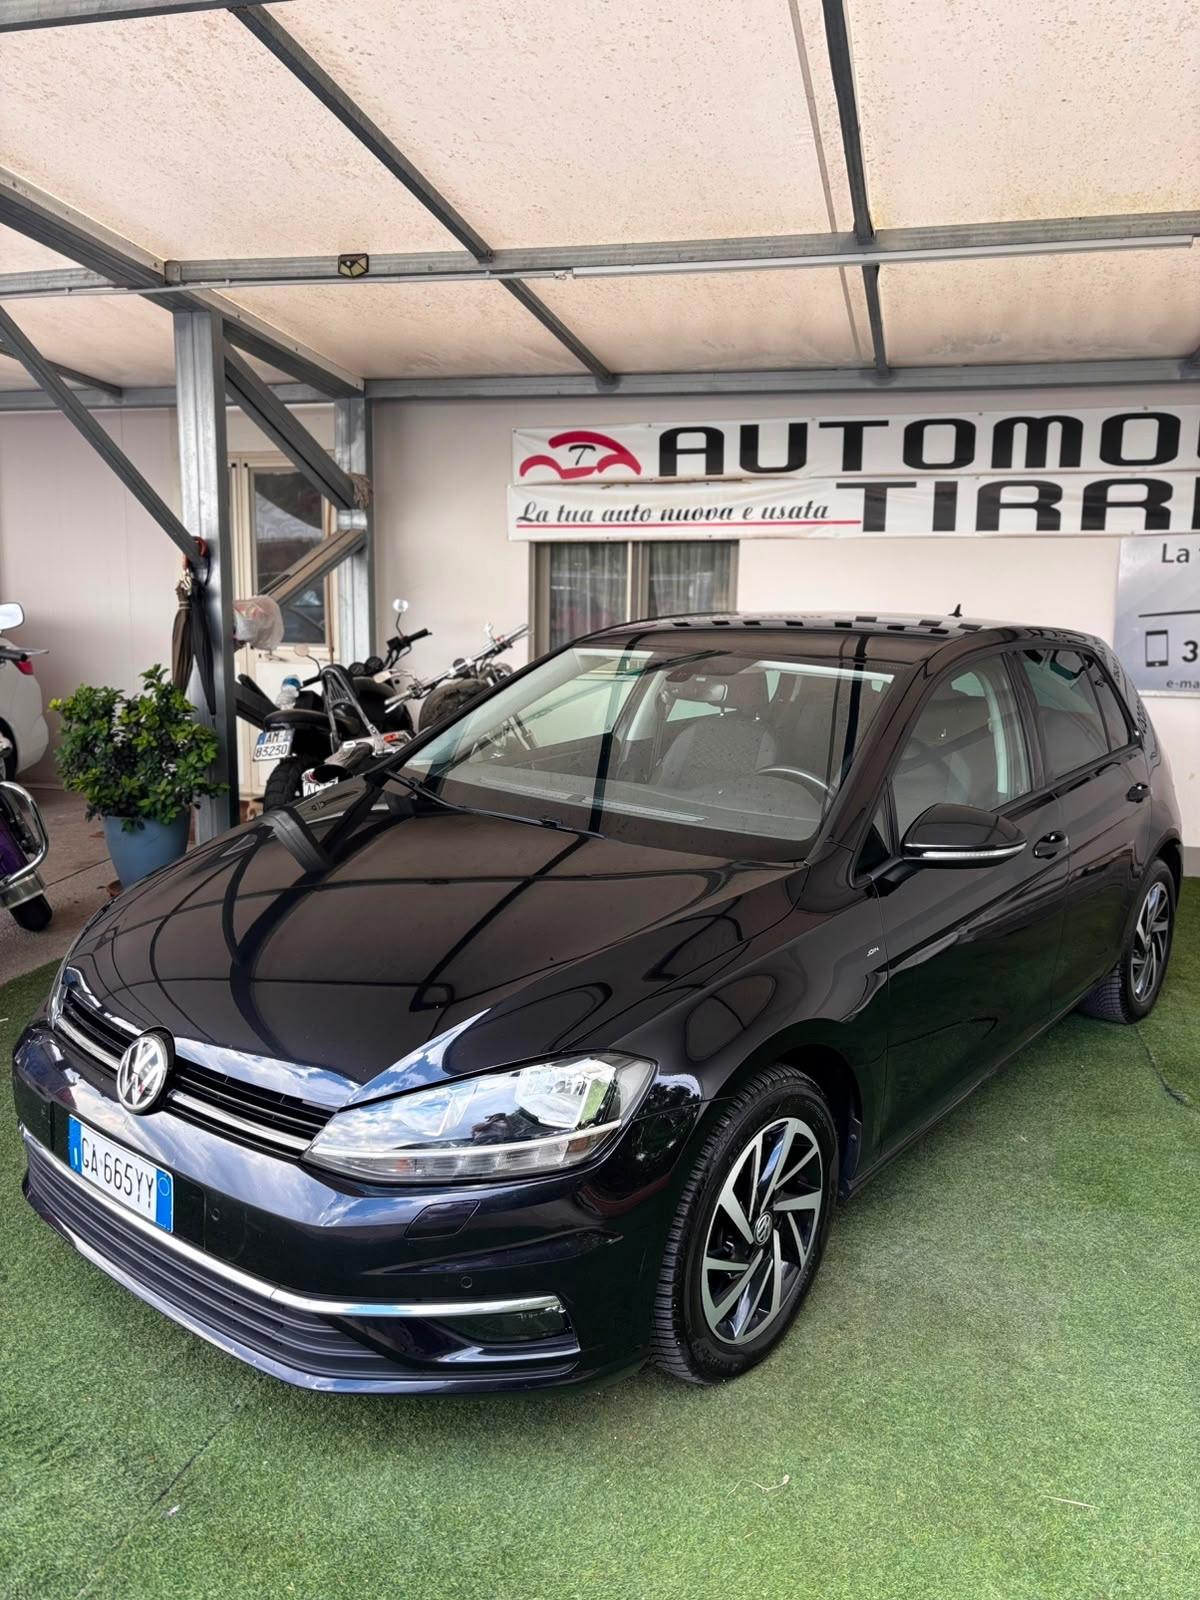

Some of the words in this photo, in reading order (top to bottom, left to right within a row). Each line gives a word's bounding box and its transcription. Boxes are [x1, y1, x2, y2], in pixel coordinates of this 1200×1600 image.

[658, 412, 1200, 477] AUTOMO
[516, 500, 549, 523] La
[556, 505, 594, 523] tua
[601, 504, 652, 522] auto
[660, 507, 734, 522] nuova
[742, 507, 754, 520] e
[761, 500, 829, 520] usata
[1161, 543, 1190, 563] La
[1181, 640, 1199, 663] 3
[104, 1152, 154, 1208] 665YY
